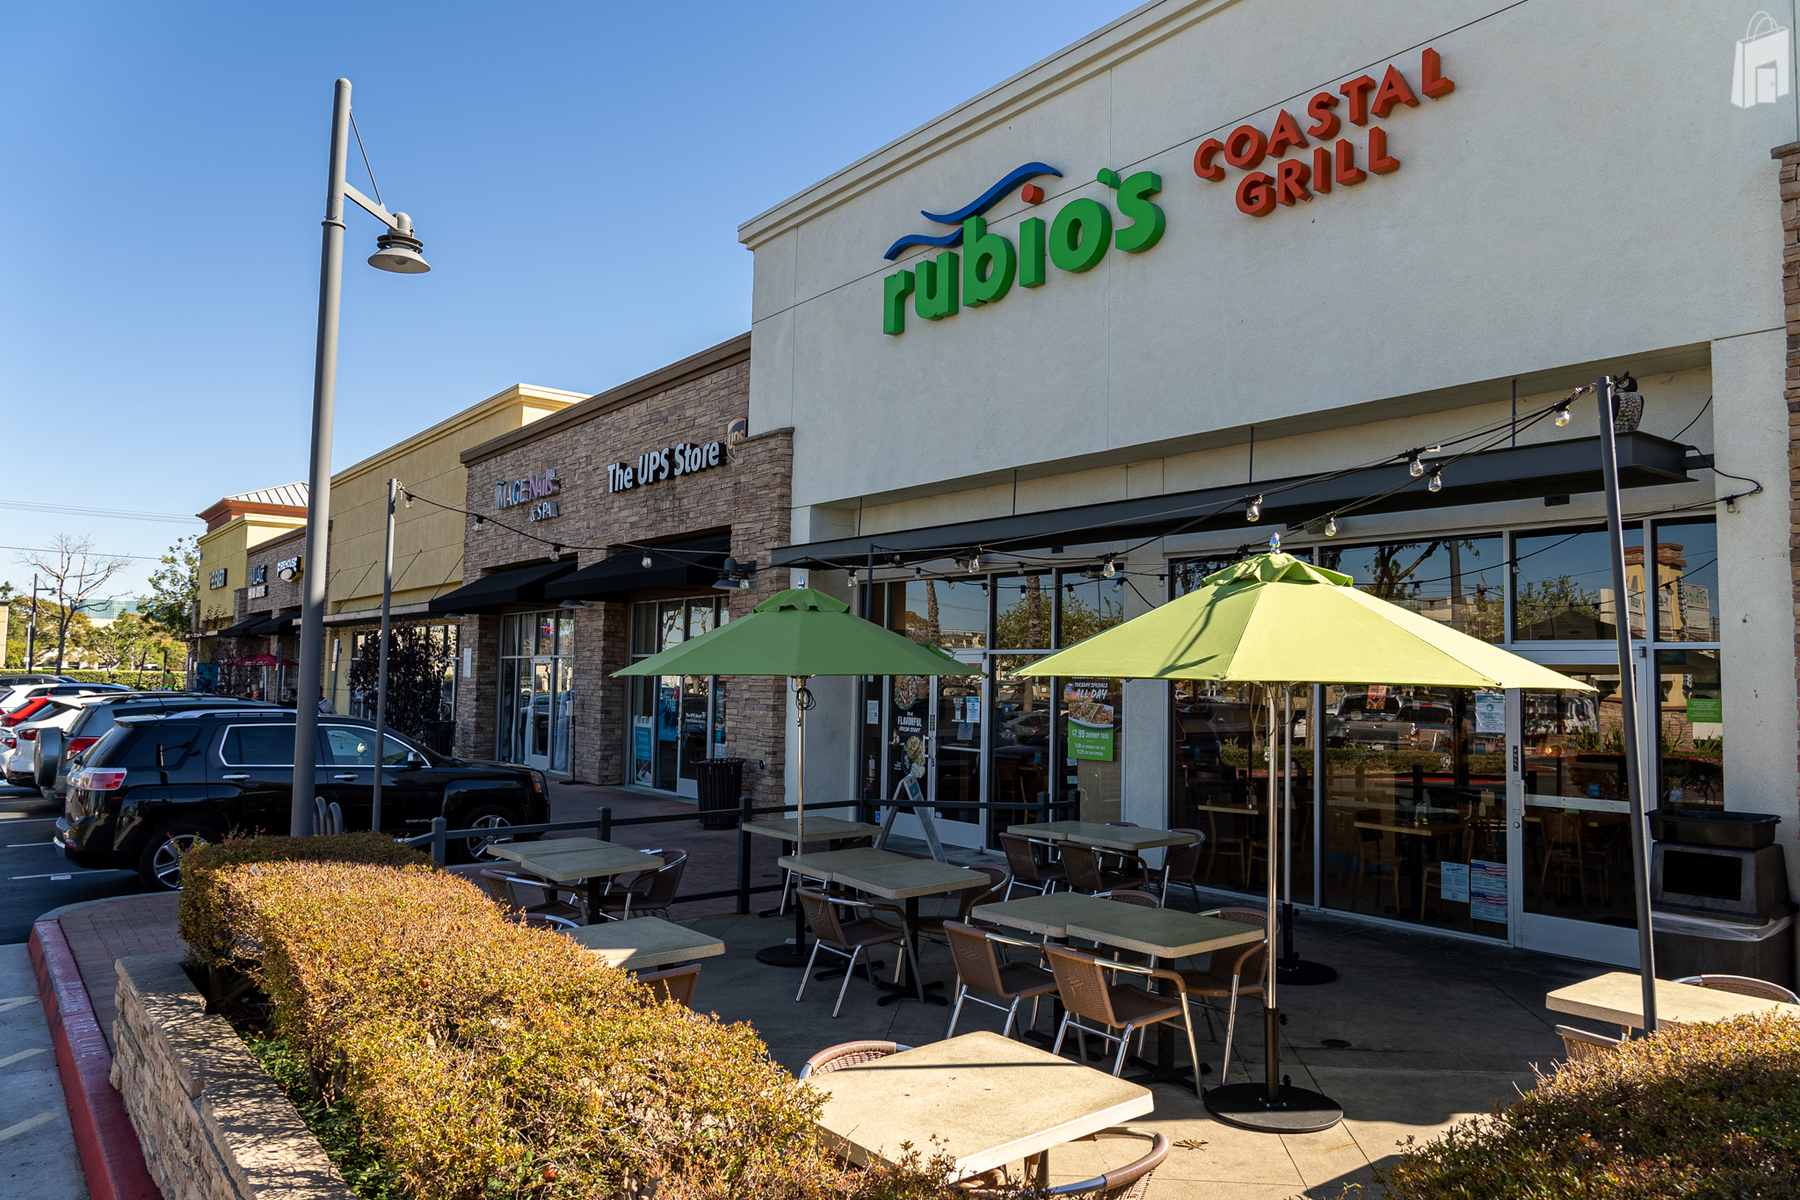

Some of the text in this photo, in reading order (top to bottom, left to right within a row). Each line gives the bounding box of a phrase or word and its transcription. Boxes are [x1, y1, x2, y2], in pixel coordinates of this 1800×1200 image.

[1193, 47, 1455, 182] COASTAL
[1235, 126, 1400, 217] GRILL
[883, 167, 1166, 335] rubio's
[607, 441, 721, 493] The UPS Store
[538, 501, 555, 520] SPA
[1074, 688, 1108, 700] ALL DAY
[897, 715, 922, 727] FLAVORFUL
